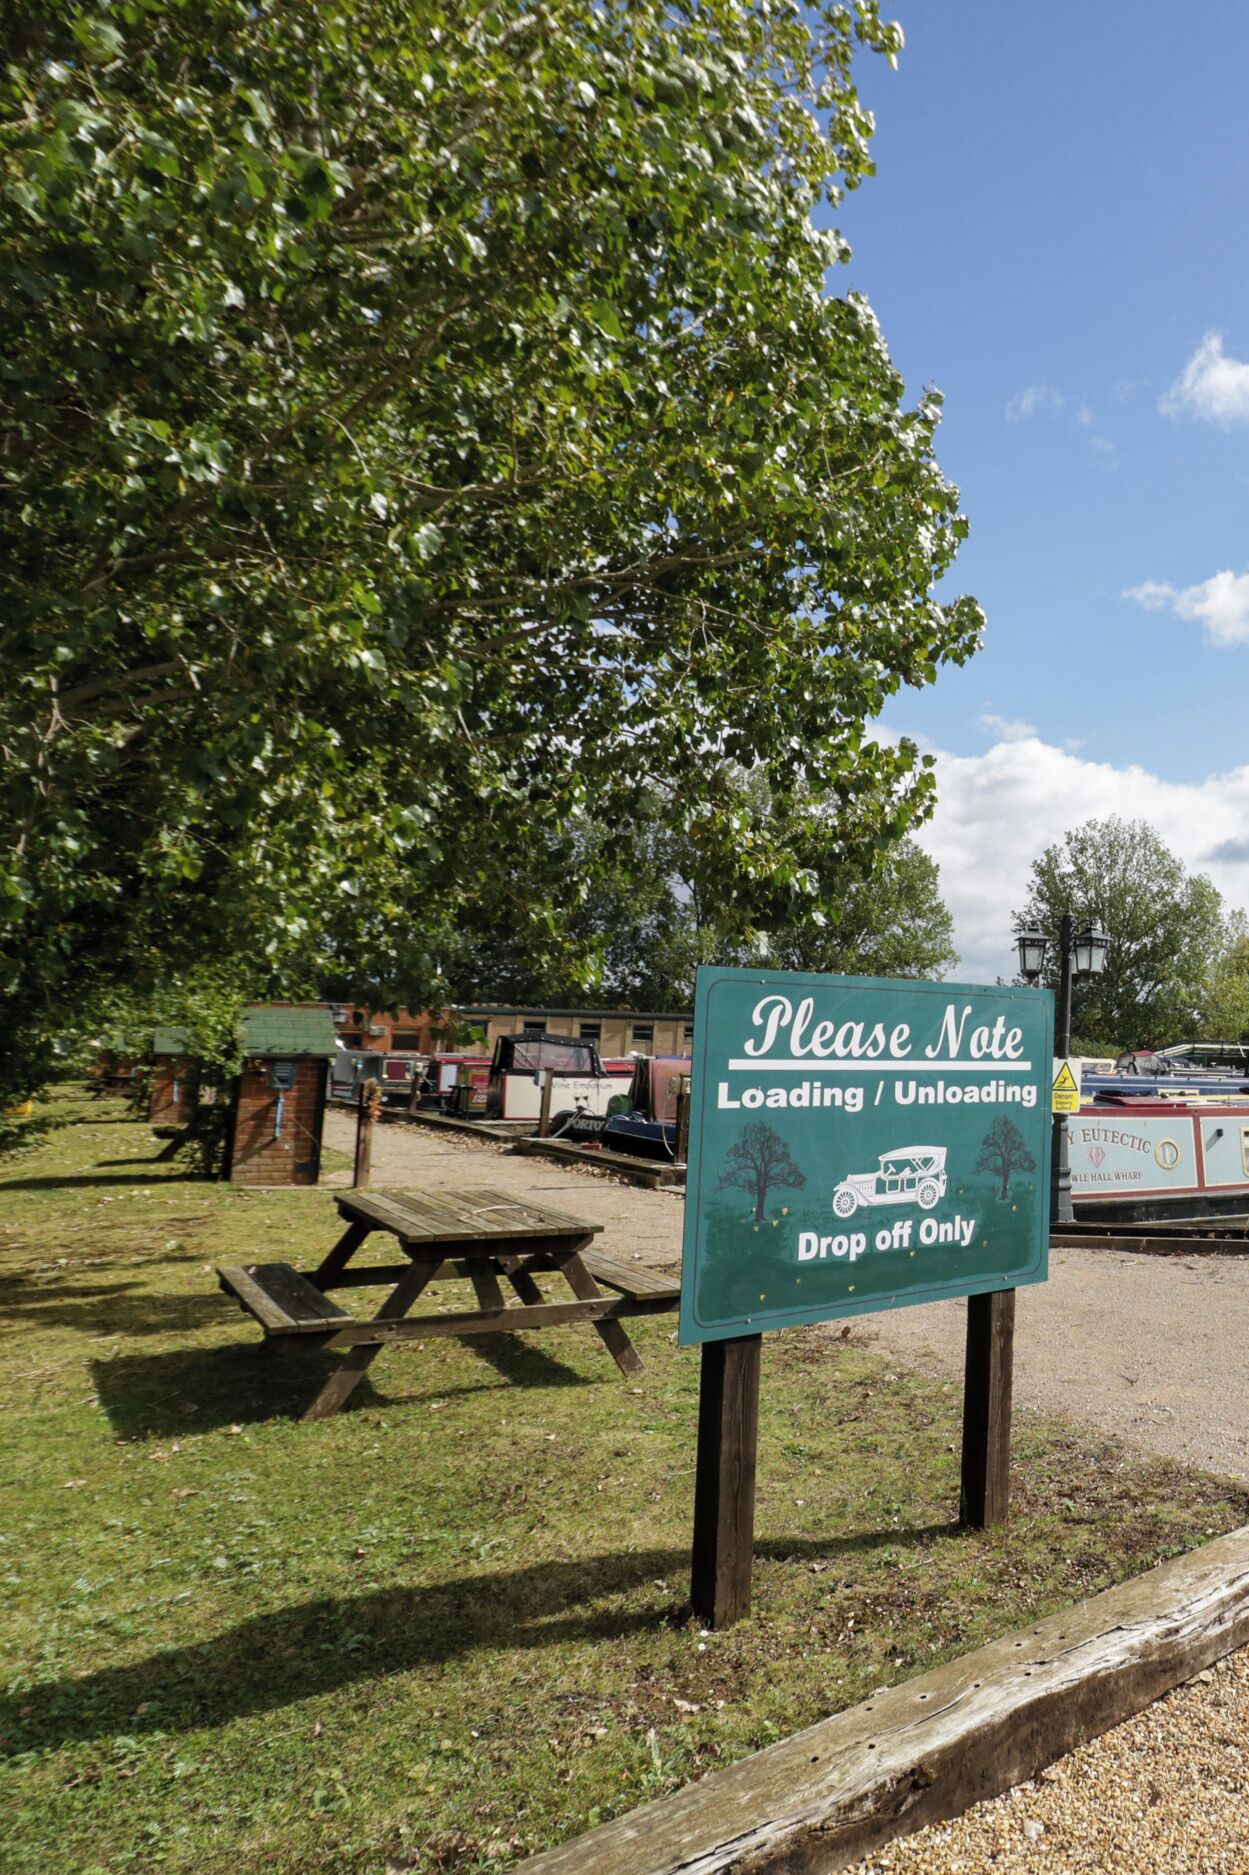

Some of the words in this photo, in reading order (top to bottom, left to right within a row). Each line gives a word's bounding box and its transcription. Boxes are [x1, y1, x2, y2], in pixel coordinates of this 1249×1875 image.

[744, 995, 912, 1058] Please
[925, 1004, 1024, 1059] Note
[573, 1080, 613, 1090] Emporium
[717, 1081, 864, 1112] Loading
[874, 1081, 884, 1106] /
[894, 1080, 1037, 1107] Unloading
[1054, 1092, 1073, 1100] Danger
[1082, 1128, 1151, 1154] EUTECTIC
[1090, 1172, 1113, 1182] HALL
[1114, 1171, 1142, 1181] WHARF
[798, 1231, 867, 1261] Drop
[875, 1220, 912, 1250] off
[919, 1215, 976, 1247] Only
